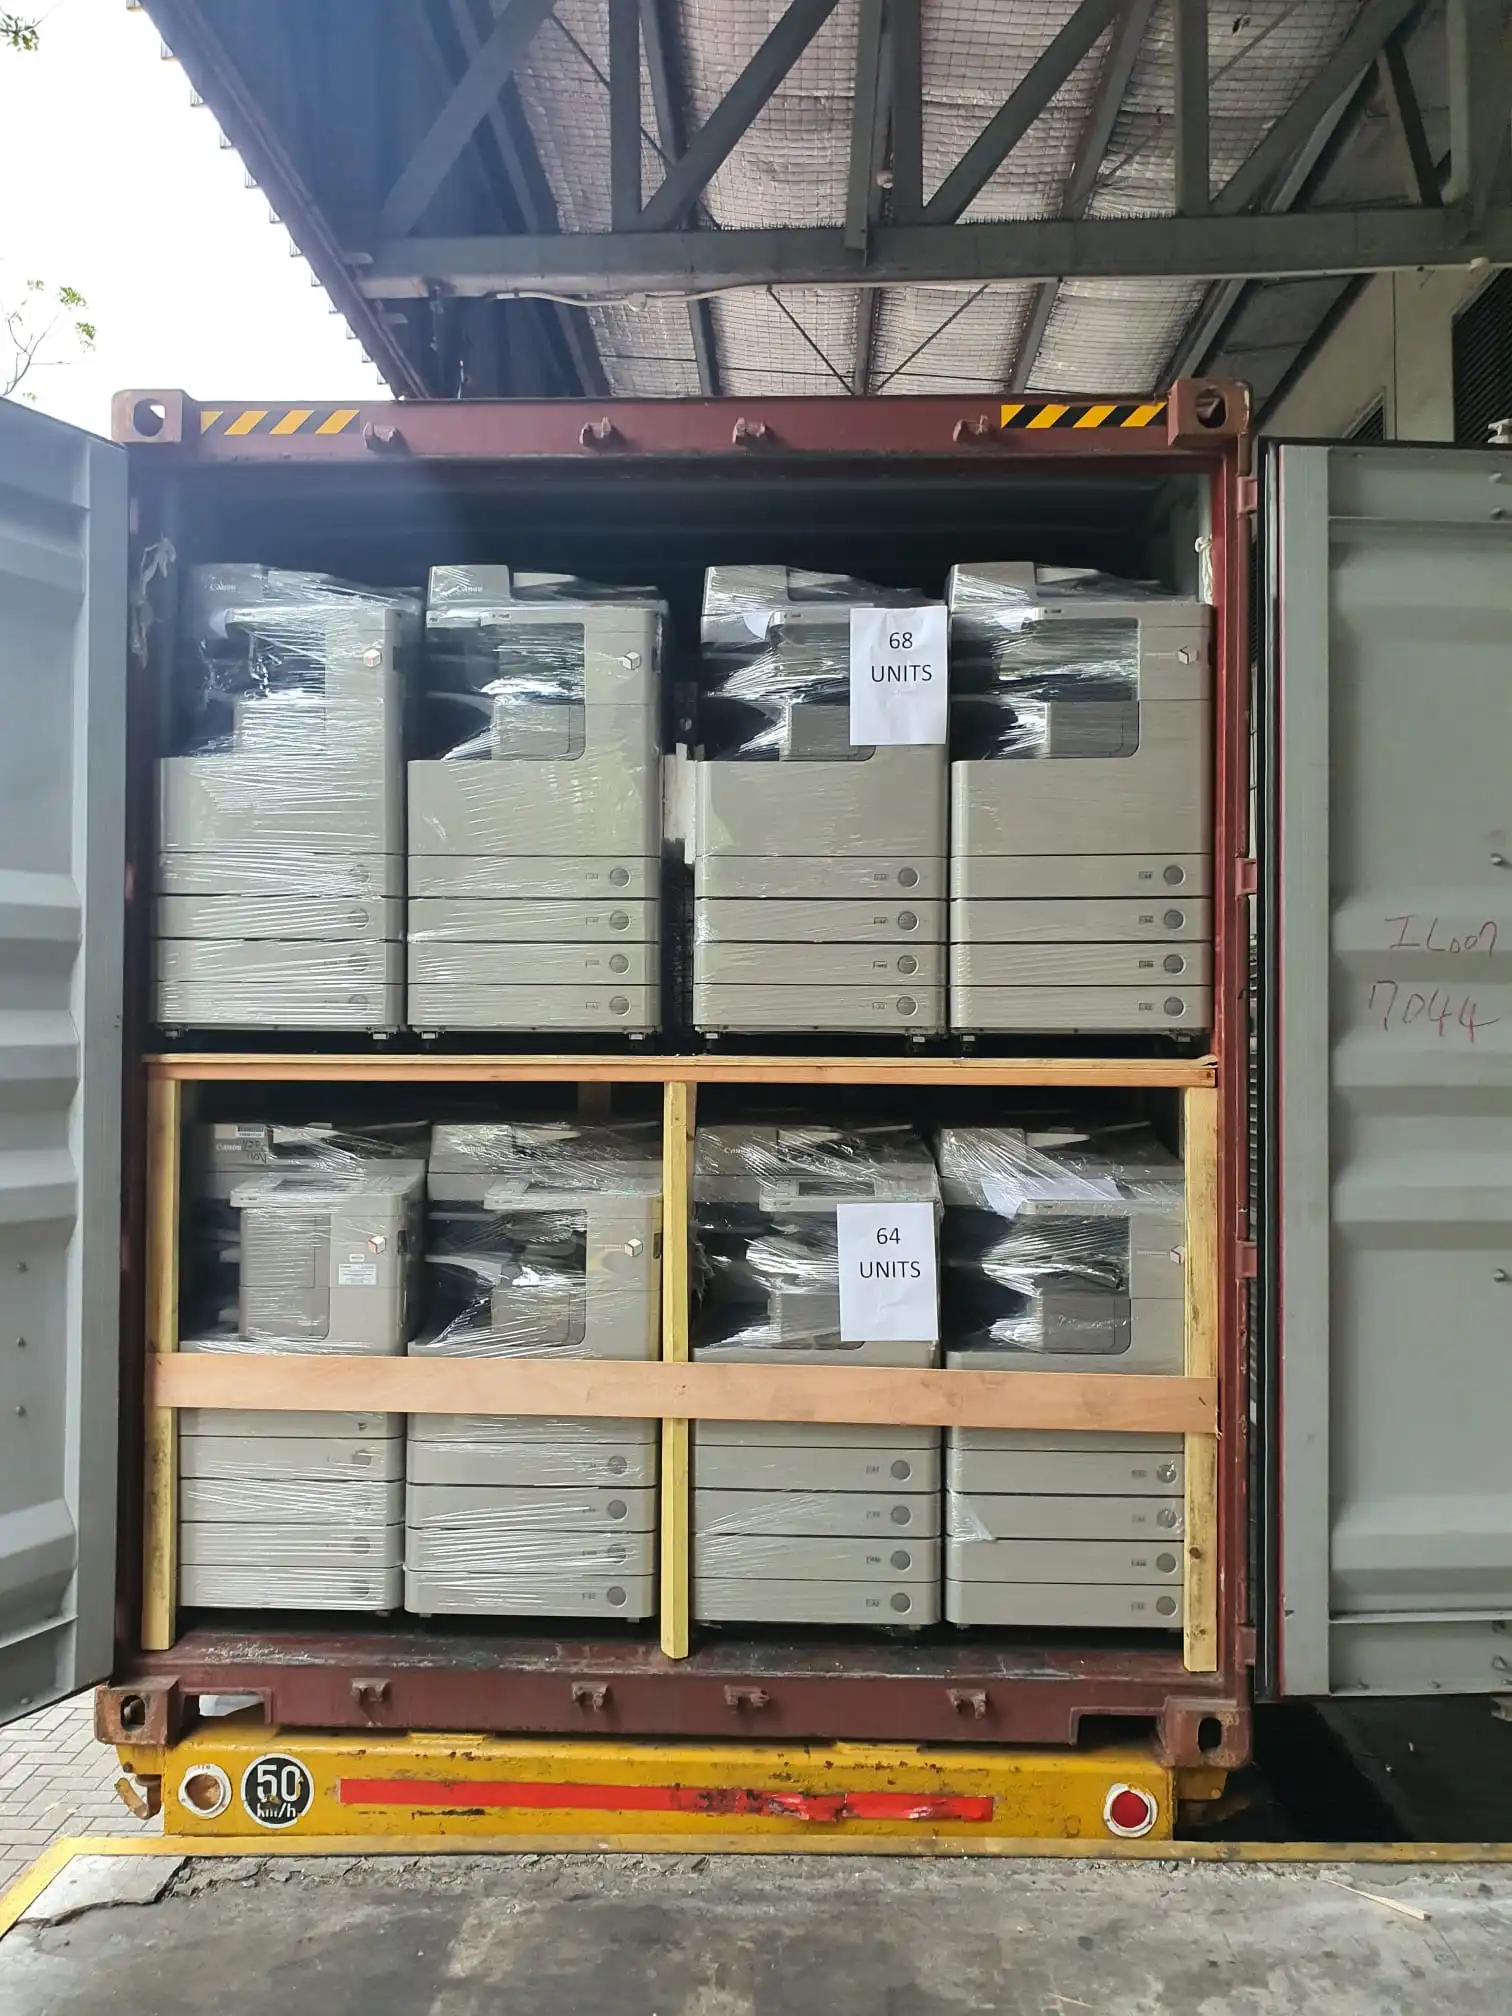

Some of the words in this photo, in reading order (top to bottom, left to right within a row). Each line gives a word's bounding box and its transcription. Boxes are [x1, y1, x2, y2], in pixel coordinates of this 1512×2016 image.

[889, 632, 913, 649] 68
[871, 664, 933, 682] UNITS
[215, 1142, 242, 1152] Canon
[876, 1227, 901, 1245] 64
[859, 1260, 921, 1279] UNITS
[257, 1764, 302, 1803] 50
[256, 1802, 297, 1818] km/h
